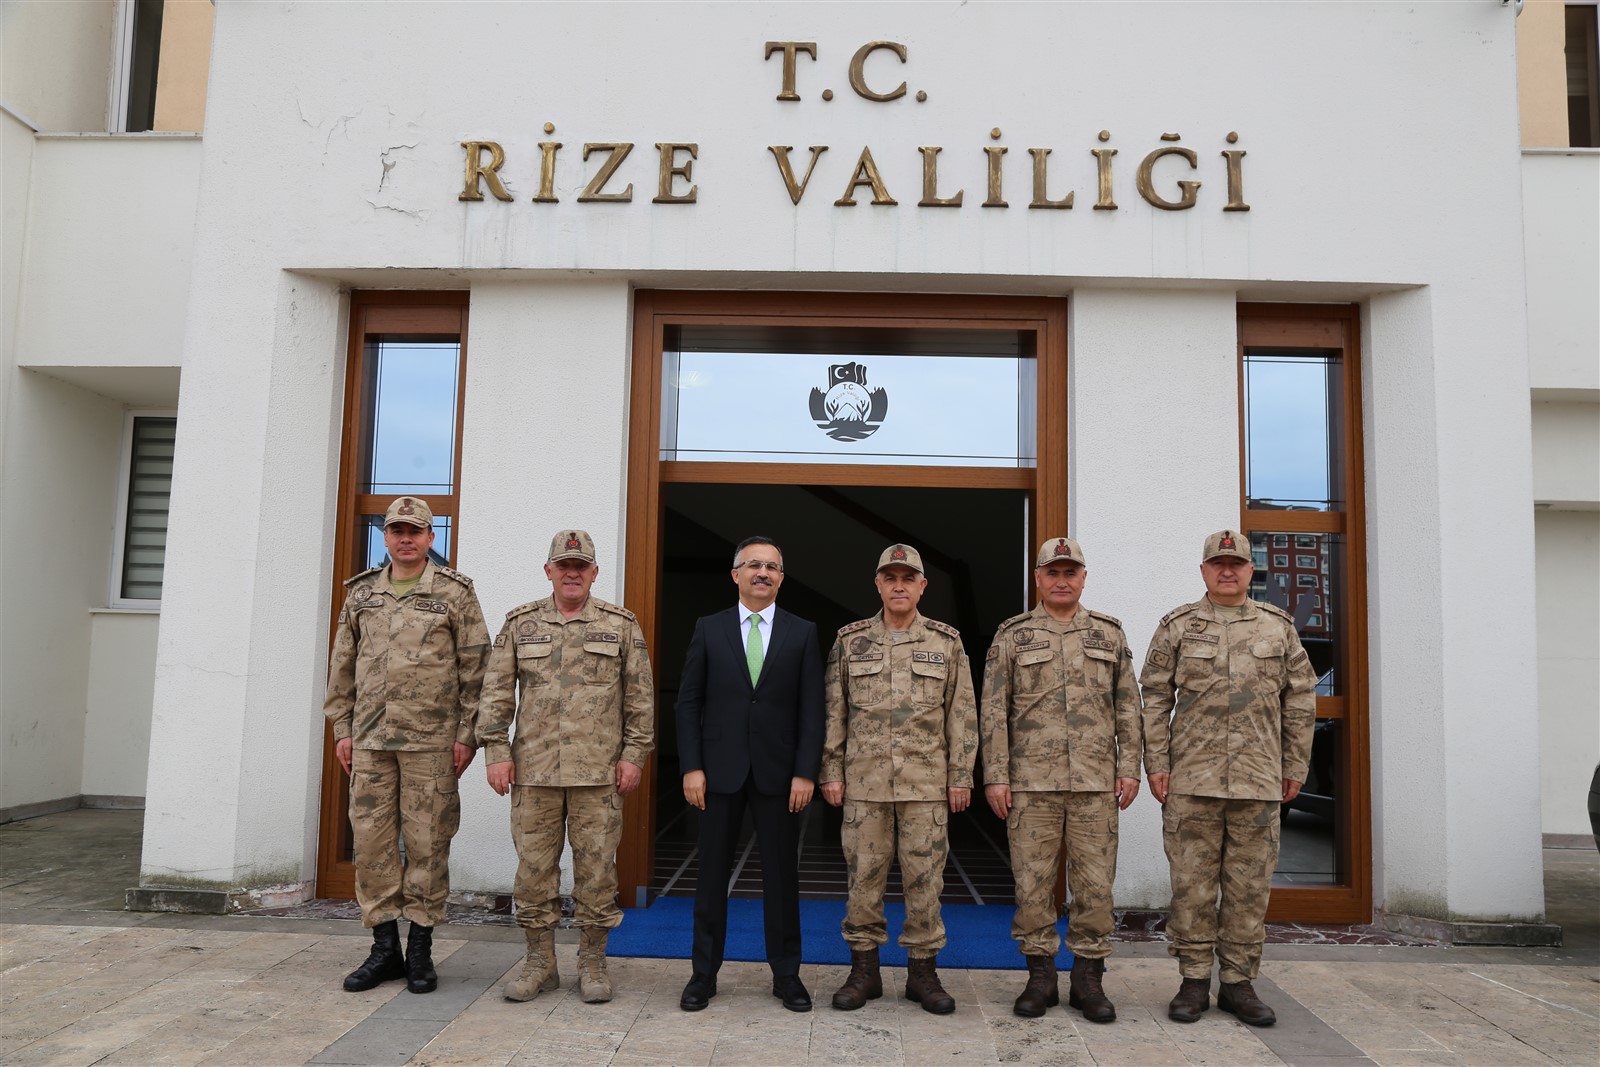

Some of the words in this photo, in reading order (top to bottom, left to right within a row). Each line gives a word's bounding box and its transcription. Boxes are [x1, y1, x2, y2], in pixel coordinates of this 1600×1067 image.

[764, 41, 927, 102] T.C.
[458, 122, 698, 204] RİZE
[768, 128, 1250, 211] VALİLİĞİ
